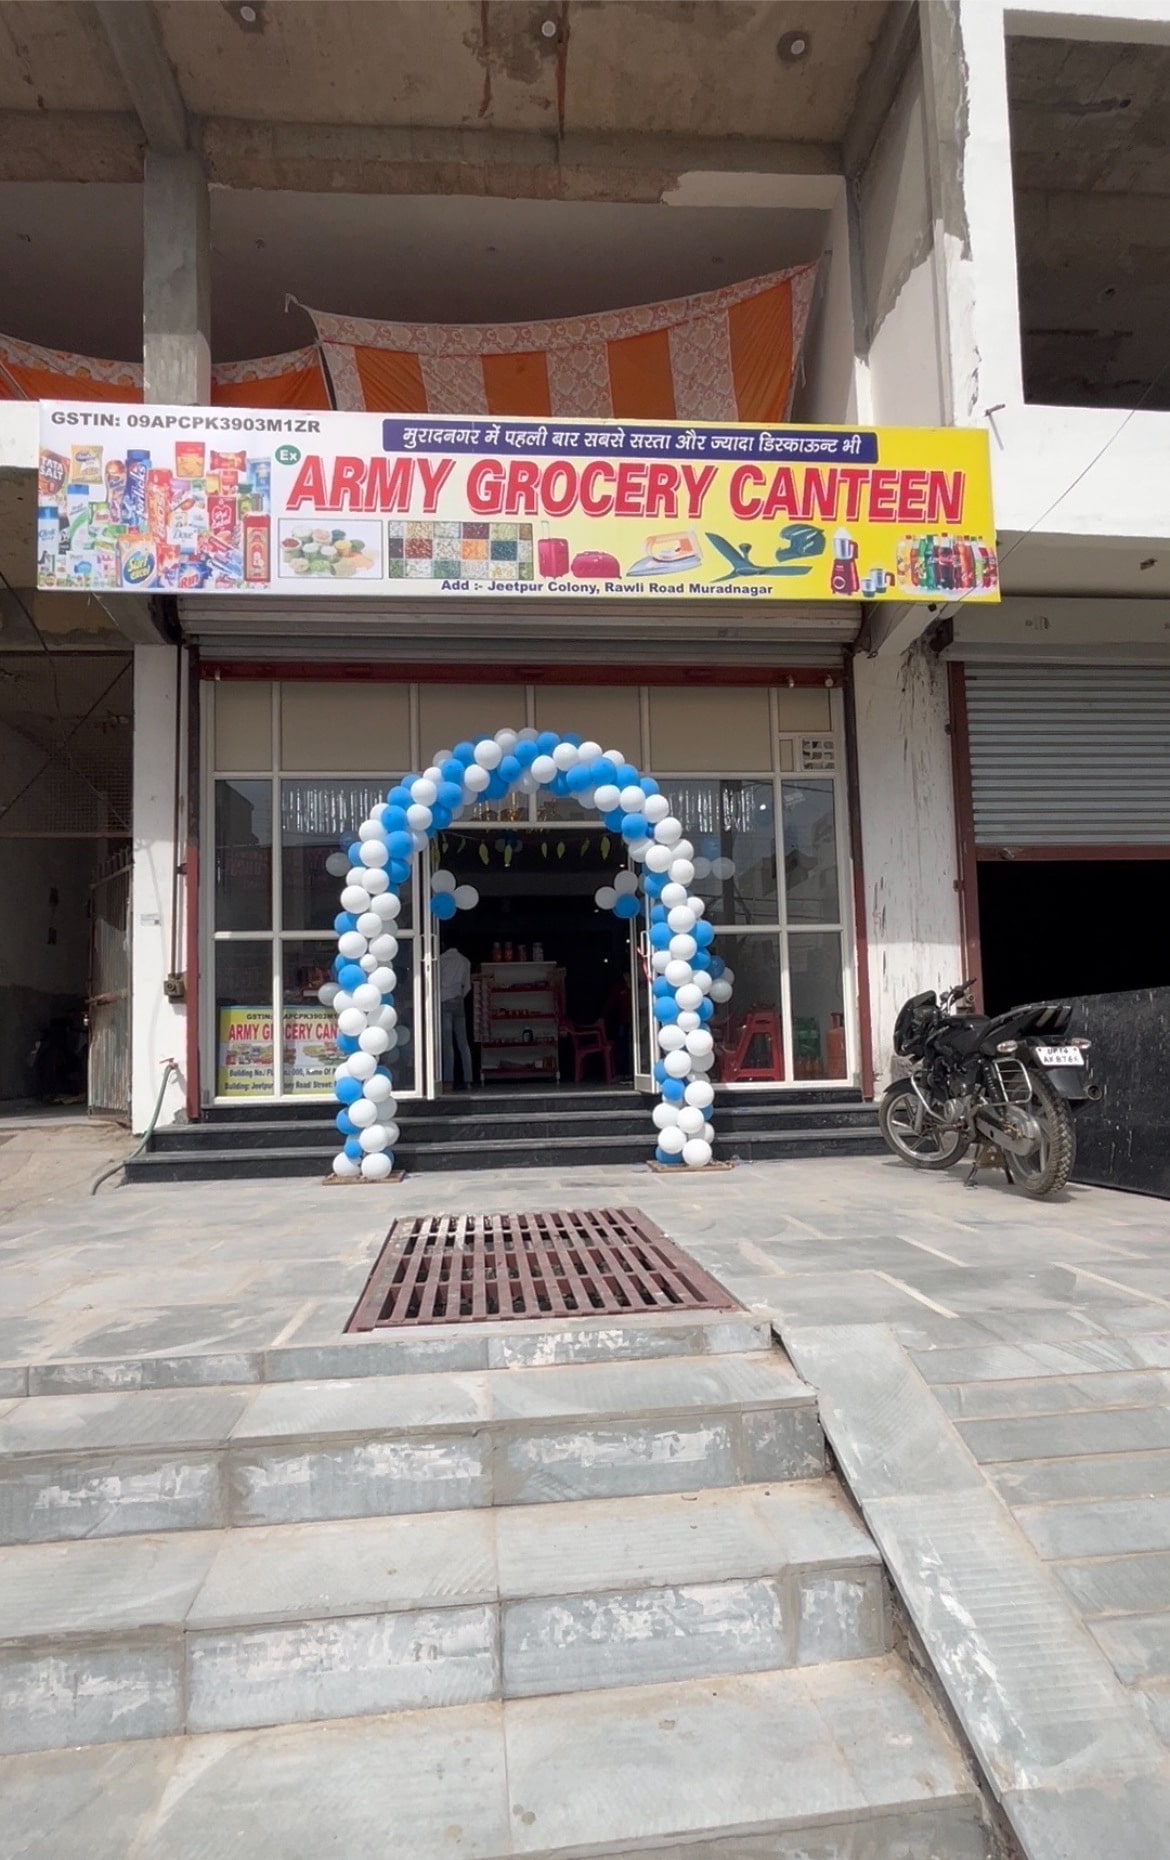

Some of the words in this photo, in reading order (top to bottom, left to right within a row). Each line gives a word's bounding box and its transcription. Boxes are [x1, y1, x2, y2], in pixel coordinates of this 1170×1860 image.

[51, 411, 120, 427] GSTIN:
[127, 413, 321, 434] 09APCPK3903M1ZR
[402, 427, 481, 449] मुरादनगर
[484, 424, 501, 445] में
[505, 426, 548, 448] पहली
[552, 431, 579, 448] बार
[584, 427, 624, 449] सबसे
[629, 432, 670, 450] सस्ता
[675, 429, 705, 451] और
[710, 434, 754, 452] ज्यादा
[842, 434, 862, 455] भी
[279, 449, 298, 462] Ex
[39, 456, 63, 472] TATA
[39, 465, 63, 481] SALT
[286, 455, 457, 512] ARMY
[466, 458, 718, 518] GROCERY
[729, 463, 966, 524] CANTEEN
[441, 580, 469, 591] Add
[487, 580, 543, 593] Jeetpur
[548, 581, 600, 595] Colony,
[604, 582, 645, 593] Rawli
[649, 583, 684, 594] Road
[688, 583, 773, 596] Muradnagar
[229, 1023, 259, 1040] ARMY
